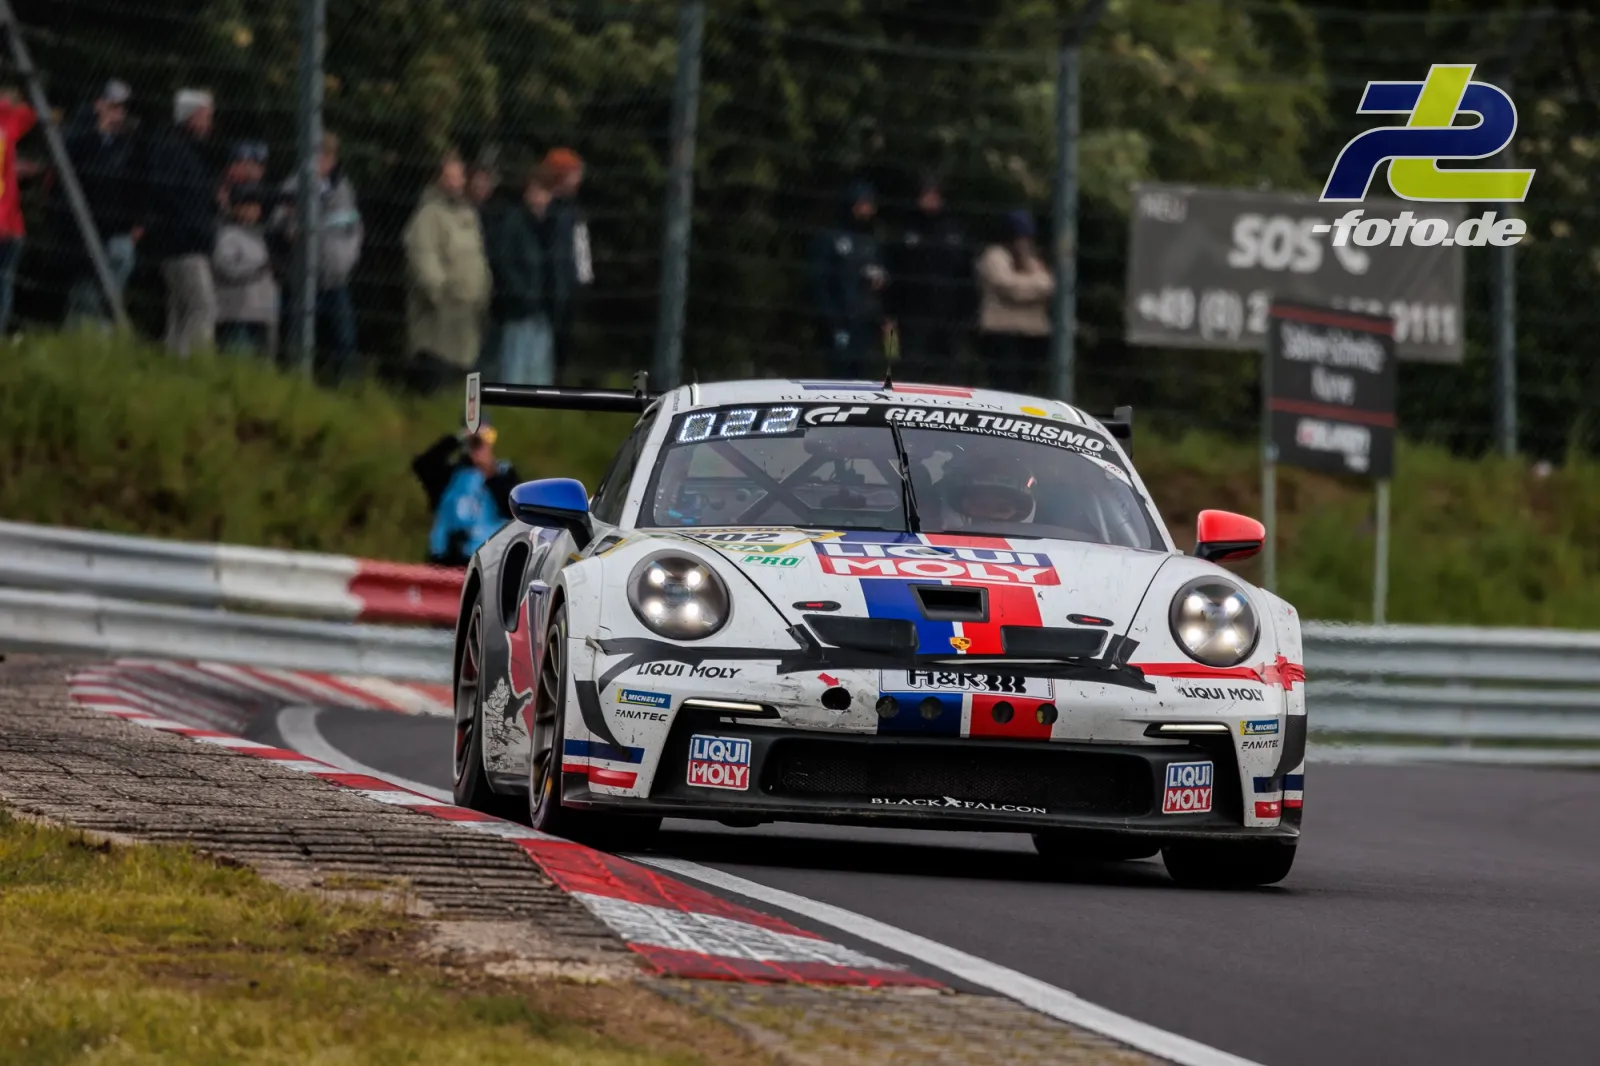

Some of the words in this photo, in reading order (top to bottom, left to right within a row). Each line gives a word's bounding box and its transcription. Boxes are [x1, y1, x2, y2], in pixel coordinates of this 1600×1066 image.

[1227, 213, 1325, 273] SOS
[780, 393, 867, 403] BLACK
[899, 395, 1004, 411] FALCON
[678, 405, 801, 444] 022
[884, 407, 962, 426] GRAN
[977, 414, 1105, 453] TURISMO
[887, 420, 906, 429] THE
[919, 422, 957, 431] REAL
[960, 426, 1019, 439] DRIVING
[1021, 435, 1102, 459] SIMULATOR
[744, 555, 799, 567] PRO
[823, 543, 1041, 567] LIQUI
[831, 557, 1051, 584] MOLY
[637, 662, 685, 677] LIQUI
[689, 666, 742, 679] MOLY
[907, 669, 986, 690] H&R
[628, 694, 666, 704] MICHELIN
[1181, 687, 1226, 700] LIQUI
[1227, 688, 1265, 702] MOLY
[615, 709, 669, 722] FANATEC
[693, 739, 747, 763] LIQUI
[691, 762, 747, 786] MOLY
[1169, 766, 1211, 787] LIQUI
[871, 797, 942, 807] BLACK
[965, 801, 1047, 814] FALCON
[1166, 788, 1211, 810] MOLY
